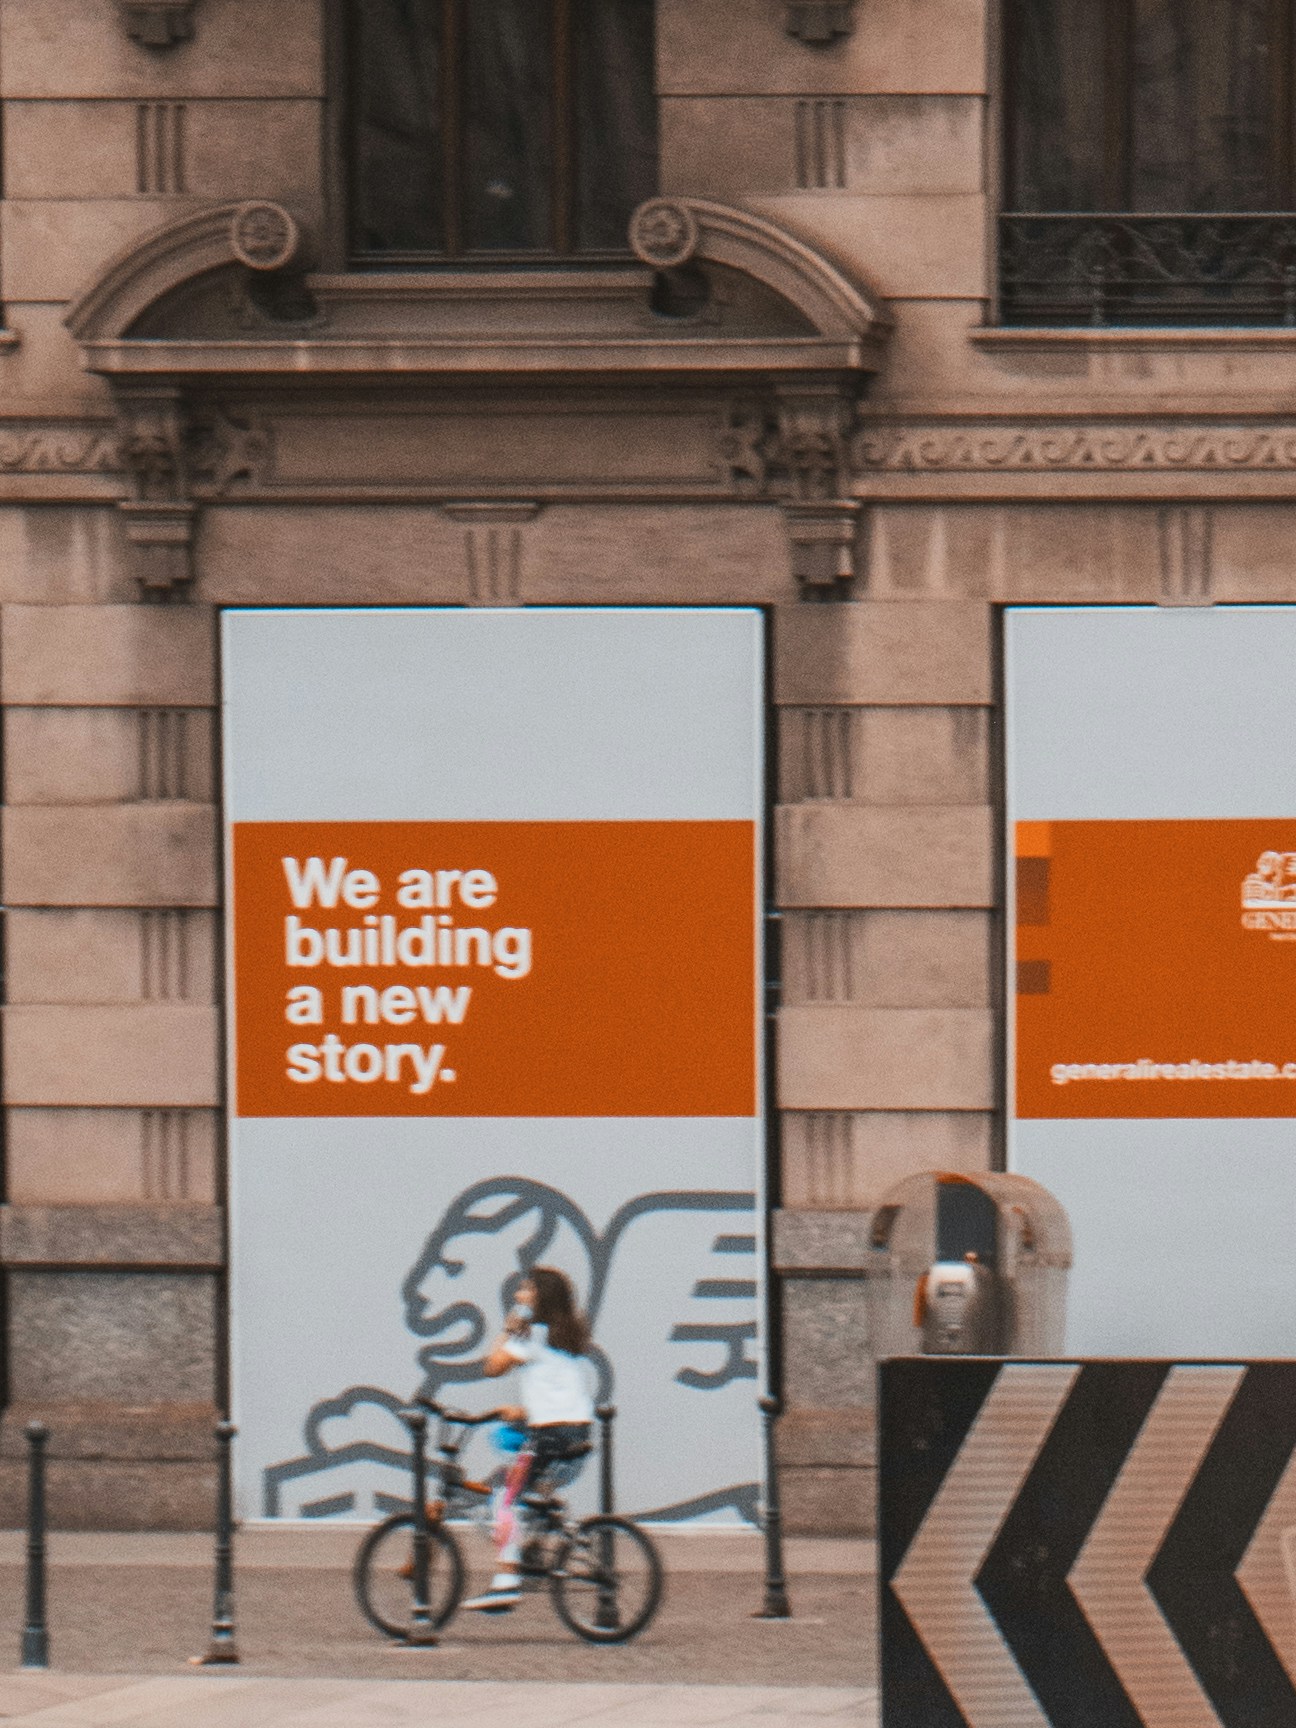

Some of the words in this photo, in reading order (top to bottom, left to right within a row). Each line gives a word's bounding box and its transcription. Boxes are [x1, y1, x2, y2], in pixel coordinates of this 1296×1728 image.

[282, 856, 381, 909] We
[397, 868, 498, 909] are
[285, 914, 533, 979] building
[284, 985, 323, 1025] a
[341, 985, 472, 1025] new
[286, 1033, 457, 1094] story.
